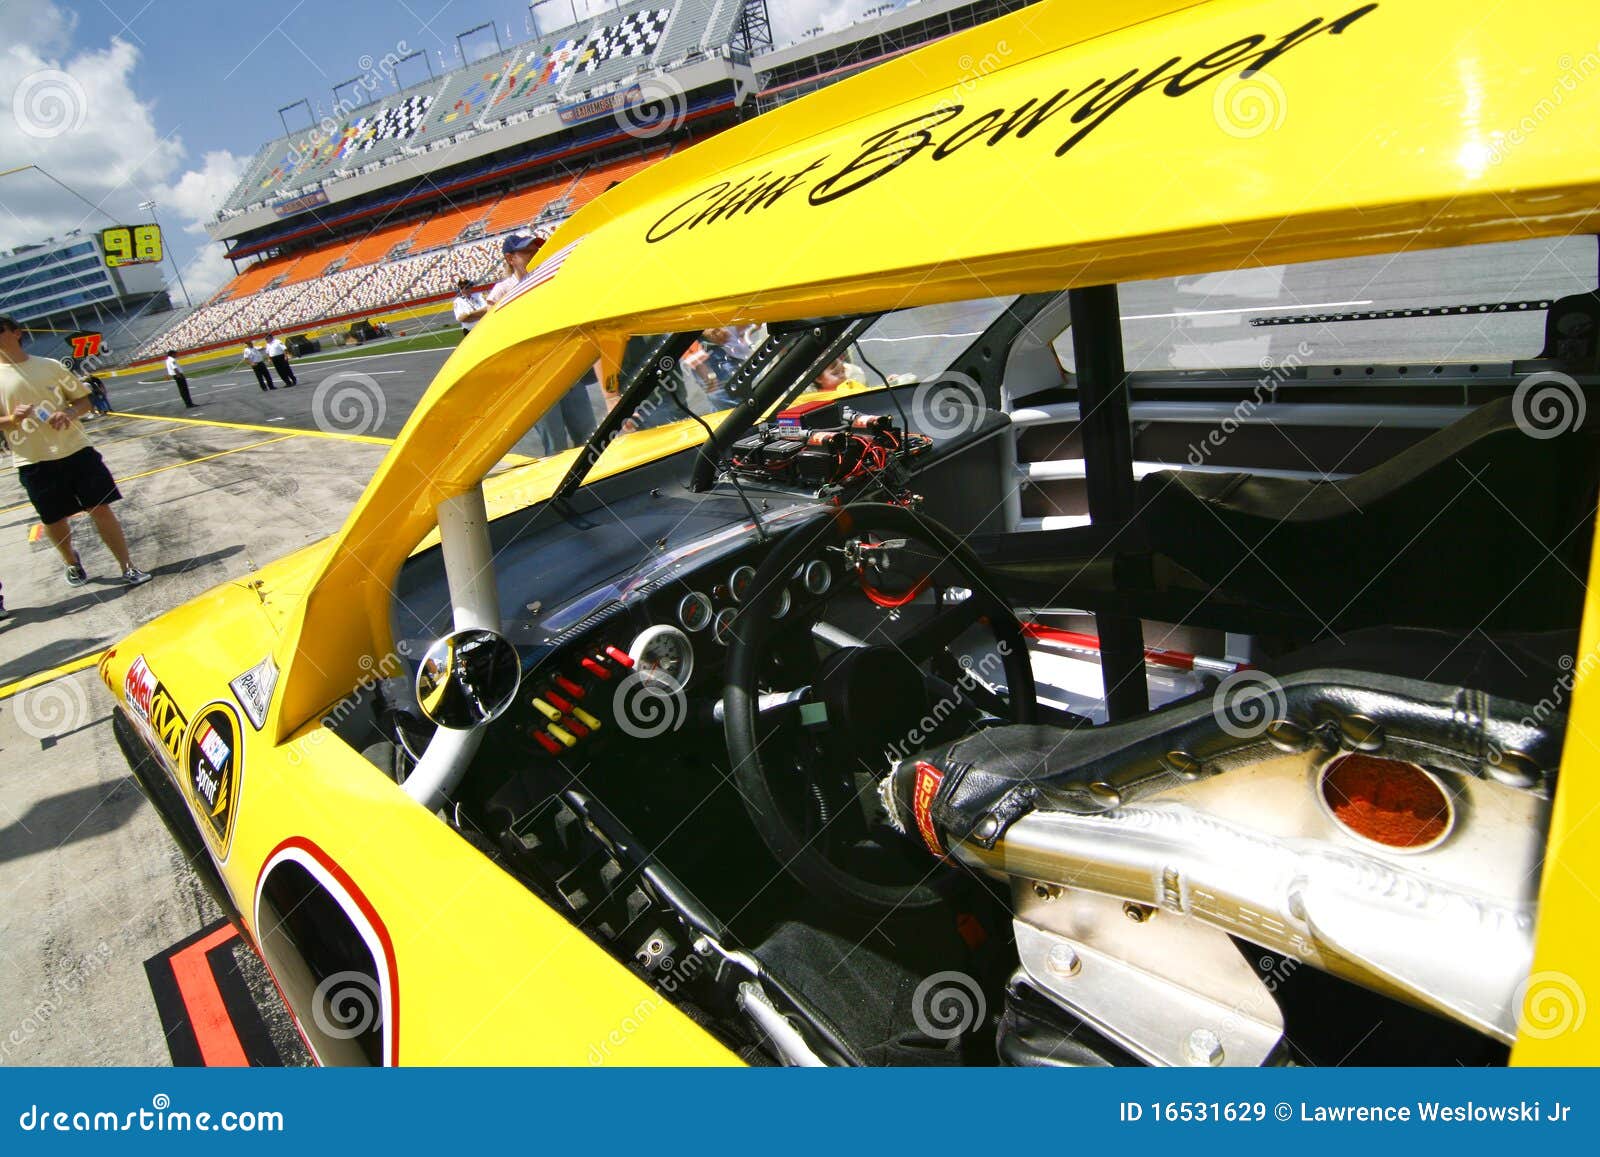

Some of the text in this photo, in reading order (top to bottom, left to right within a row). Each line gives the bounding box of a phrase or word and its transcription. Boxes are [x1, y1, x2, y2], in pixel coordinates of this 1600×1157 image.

[645, 3, 1379, 244] Clint Bowyer
[104, 226, 162, 268] 98
[71, 334, 101, 358] 77
[196, 758, 219, 806] Sprint
